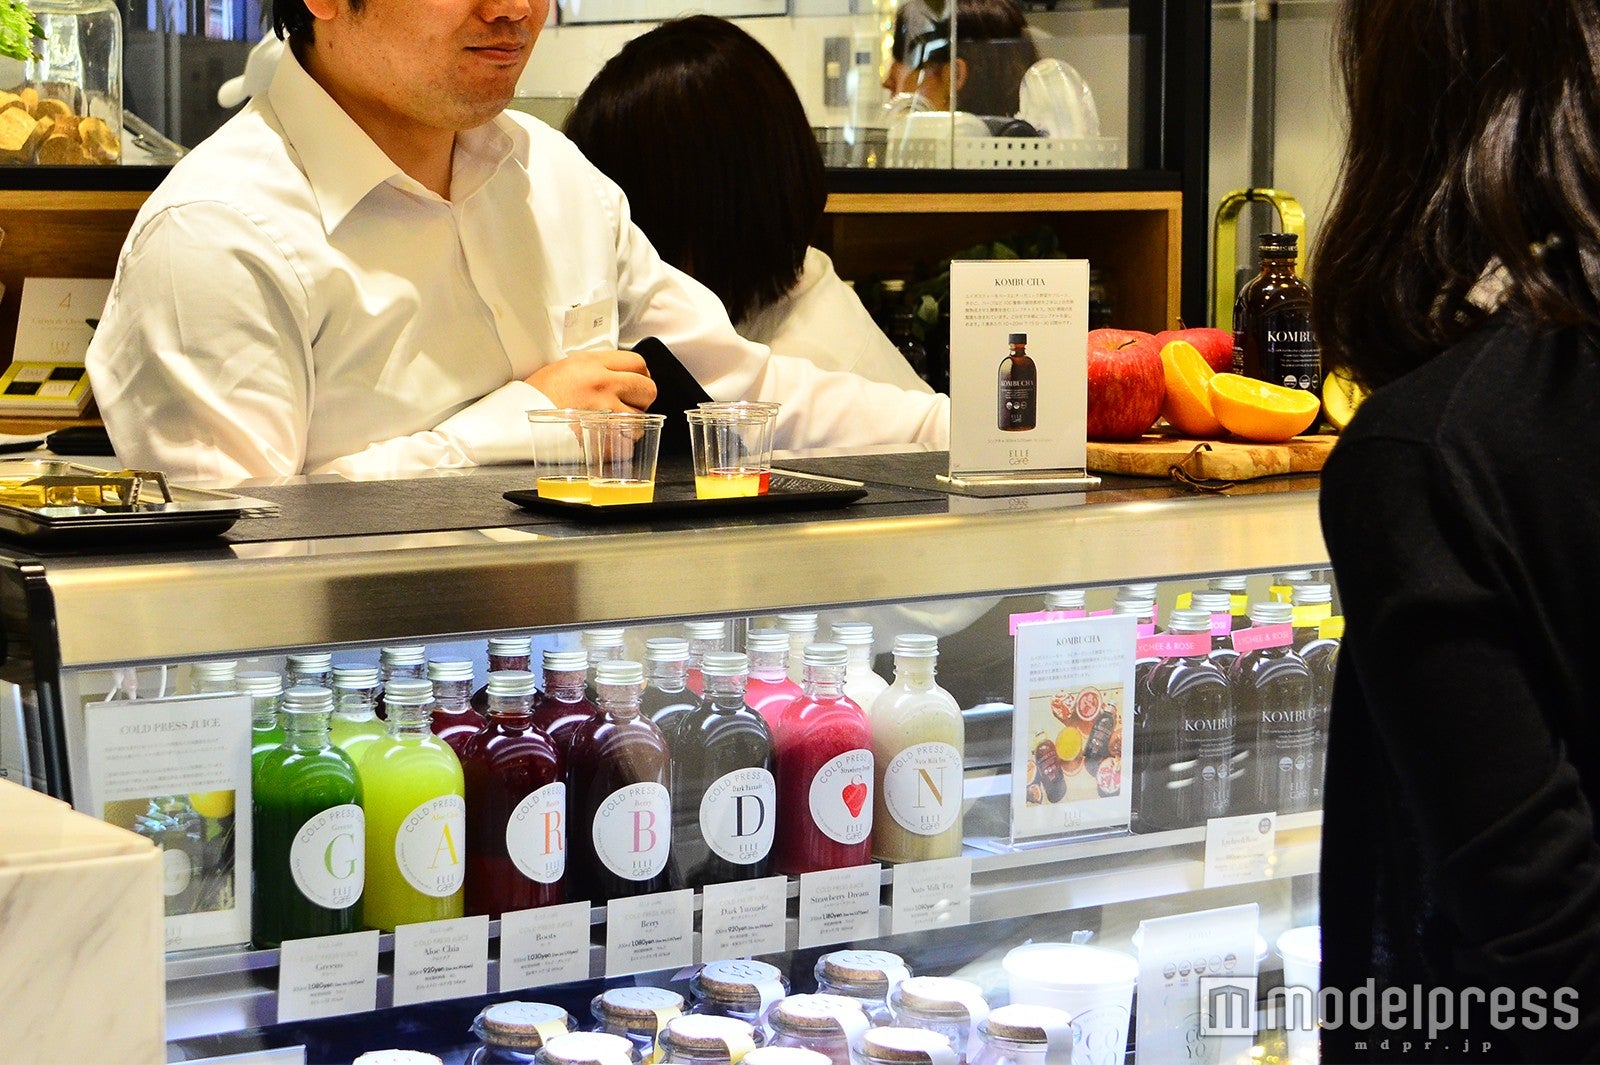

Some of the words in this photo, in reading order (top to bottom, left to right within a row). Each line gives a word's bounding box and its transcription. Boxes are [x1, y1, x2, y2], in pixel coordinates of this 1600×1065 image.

[994, 278, 1046, 287] KOMBUCHA
[1056, 635, 1101, 647] KOMBUCHA
[1138, 641, 1165, 651] YCHEE
[1174, 641, 1195, 650] ROSE
[120, 724, 151, 735] COLD
[154, 721, 187, 732] PRESS
[190, 718, 221, 729] JUICE
[820, 760, 843, 784] COLD
[891, 751, 914, 774] COLD
[917, 745, 945, 755] PRESS
[708, 779, 731, 803] COLD
[735, 771, 761, 782] PRESS
[912, 766, 947, 808] N
[516, 795, 540, 822] COLD
[602, 793, 626, 818] COLD
[629, 787, 656, 797] PRESS
[405, 807, 430, 833] COLD
[730, 794, 764, 838] D
[301, 817, 326, 843] COLD
[537, 810, 563, 855] R
[628, 810, 656, 853] B
[324, 833, 357, 880] G
[427, 823, 458, 870] A
[811, 894, 845, 903] Strawberry
[847, 891, 870, 899] Dream
[641, 920, 659, 929] Berry
[721, 908, 737, 916] Dark
[442, 945, 460, 953] Chia
